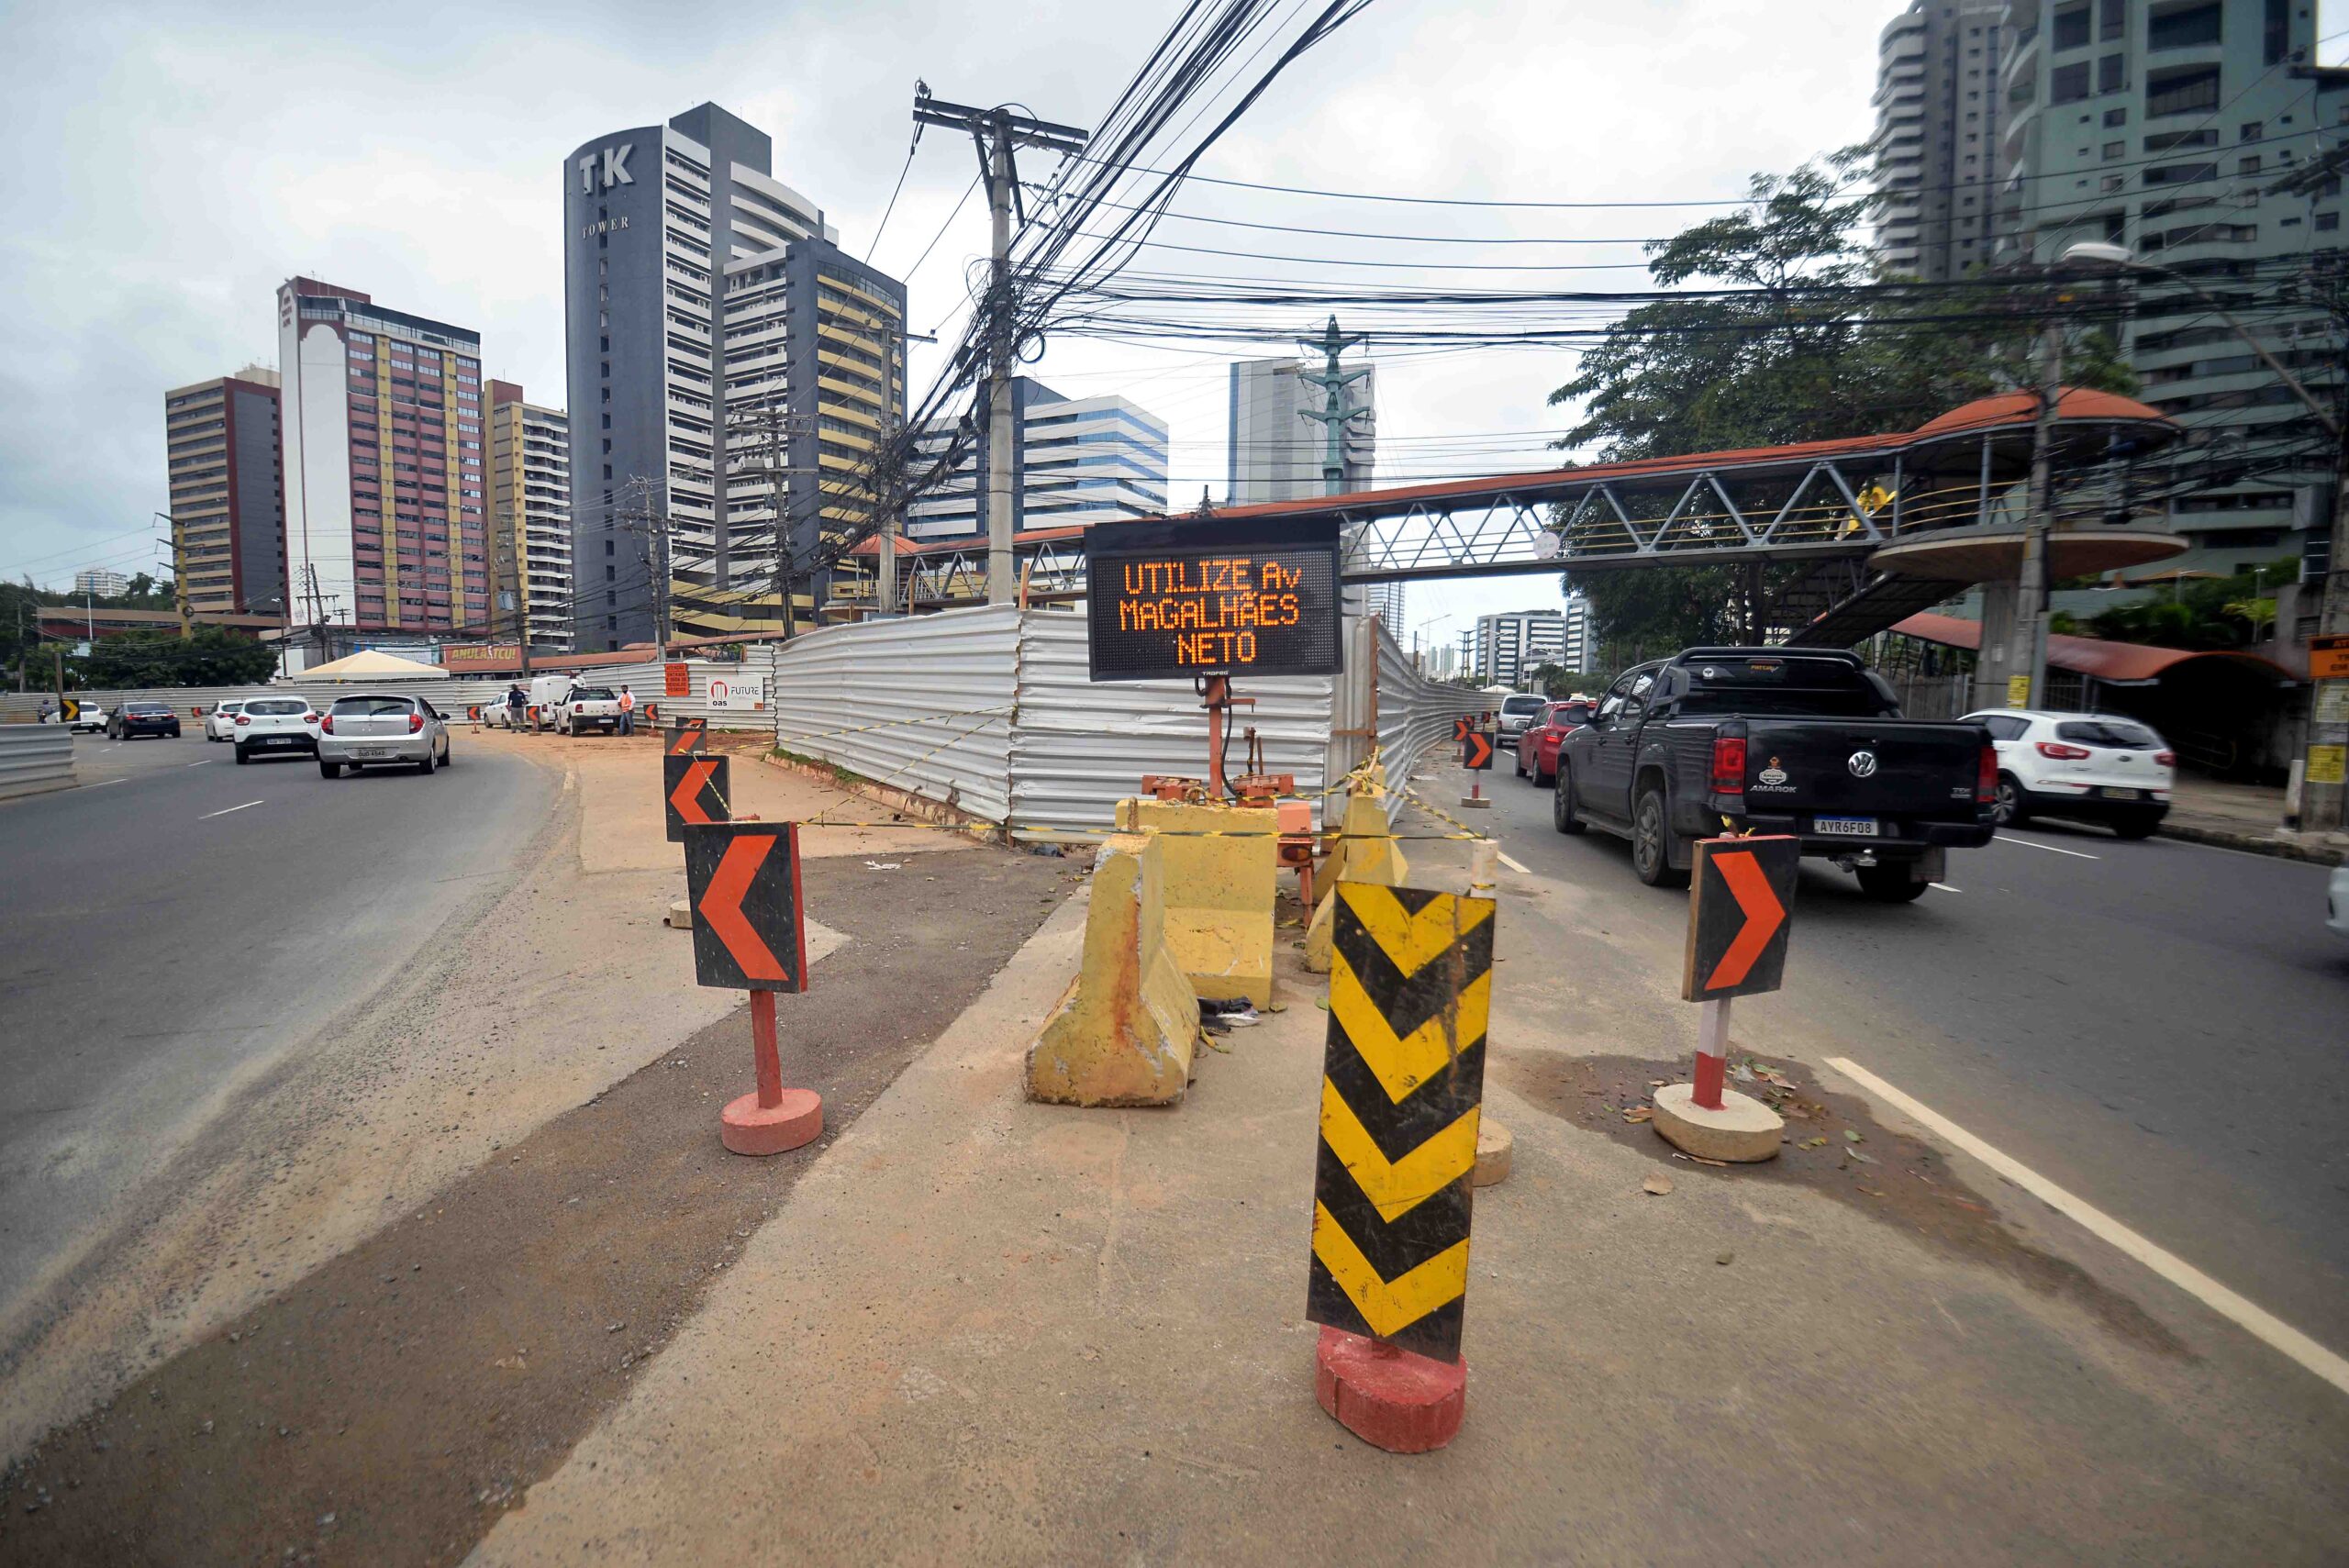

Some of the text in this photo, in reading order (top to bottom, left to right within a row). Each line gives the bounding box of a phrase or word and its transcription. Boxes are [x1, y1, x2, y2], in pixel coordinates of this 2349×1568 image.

[579, 143, 635, 195] TK
[583, 217, 629, 239] TOWER
[1125, 559, 1302, 595] UTILIZE Av
[1119, 591, 1300, 631] MAGALHÃES
[1177, 630, 1257, 664] NETO
[730, 686, 760, 695] FUTURE
[1820, 821, 1872, 833] AYR6F08
